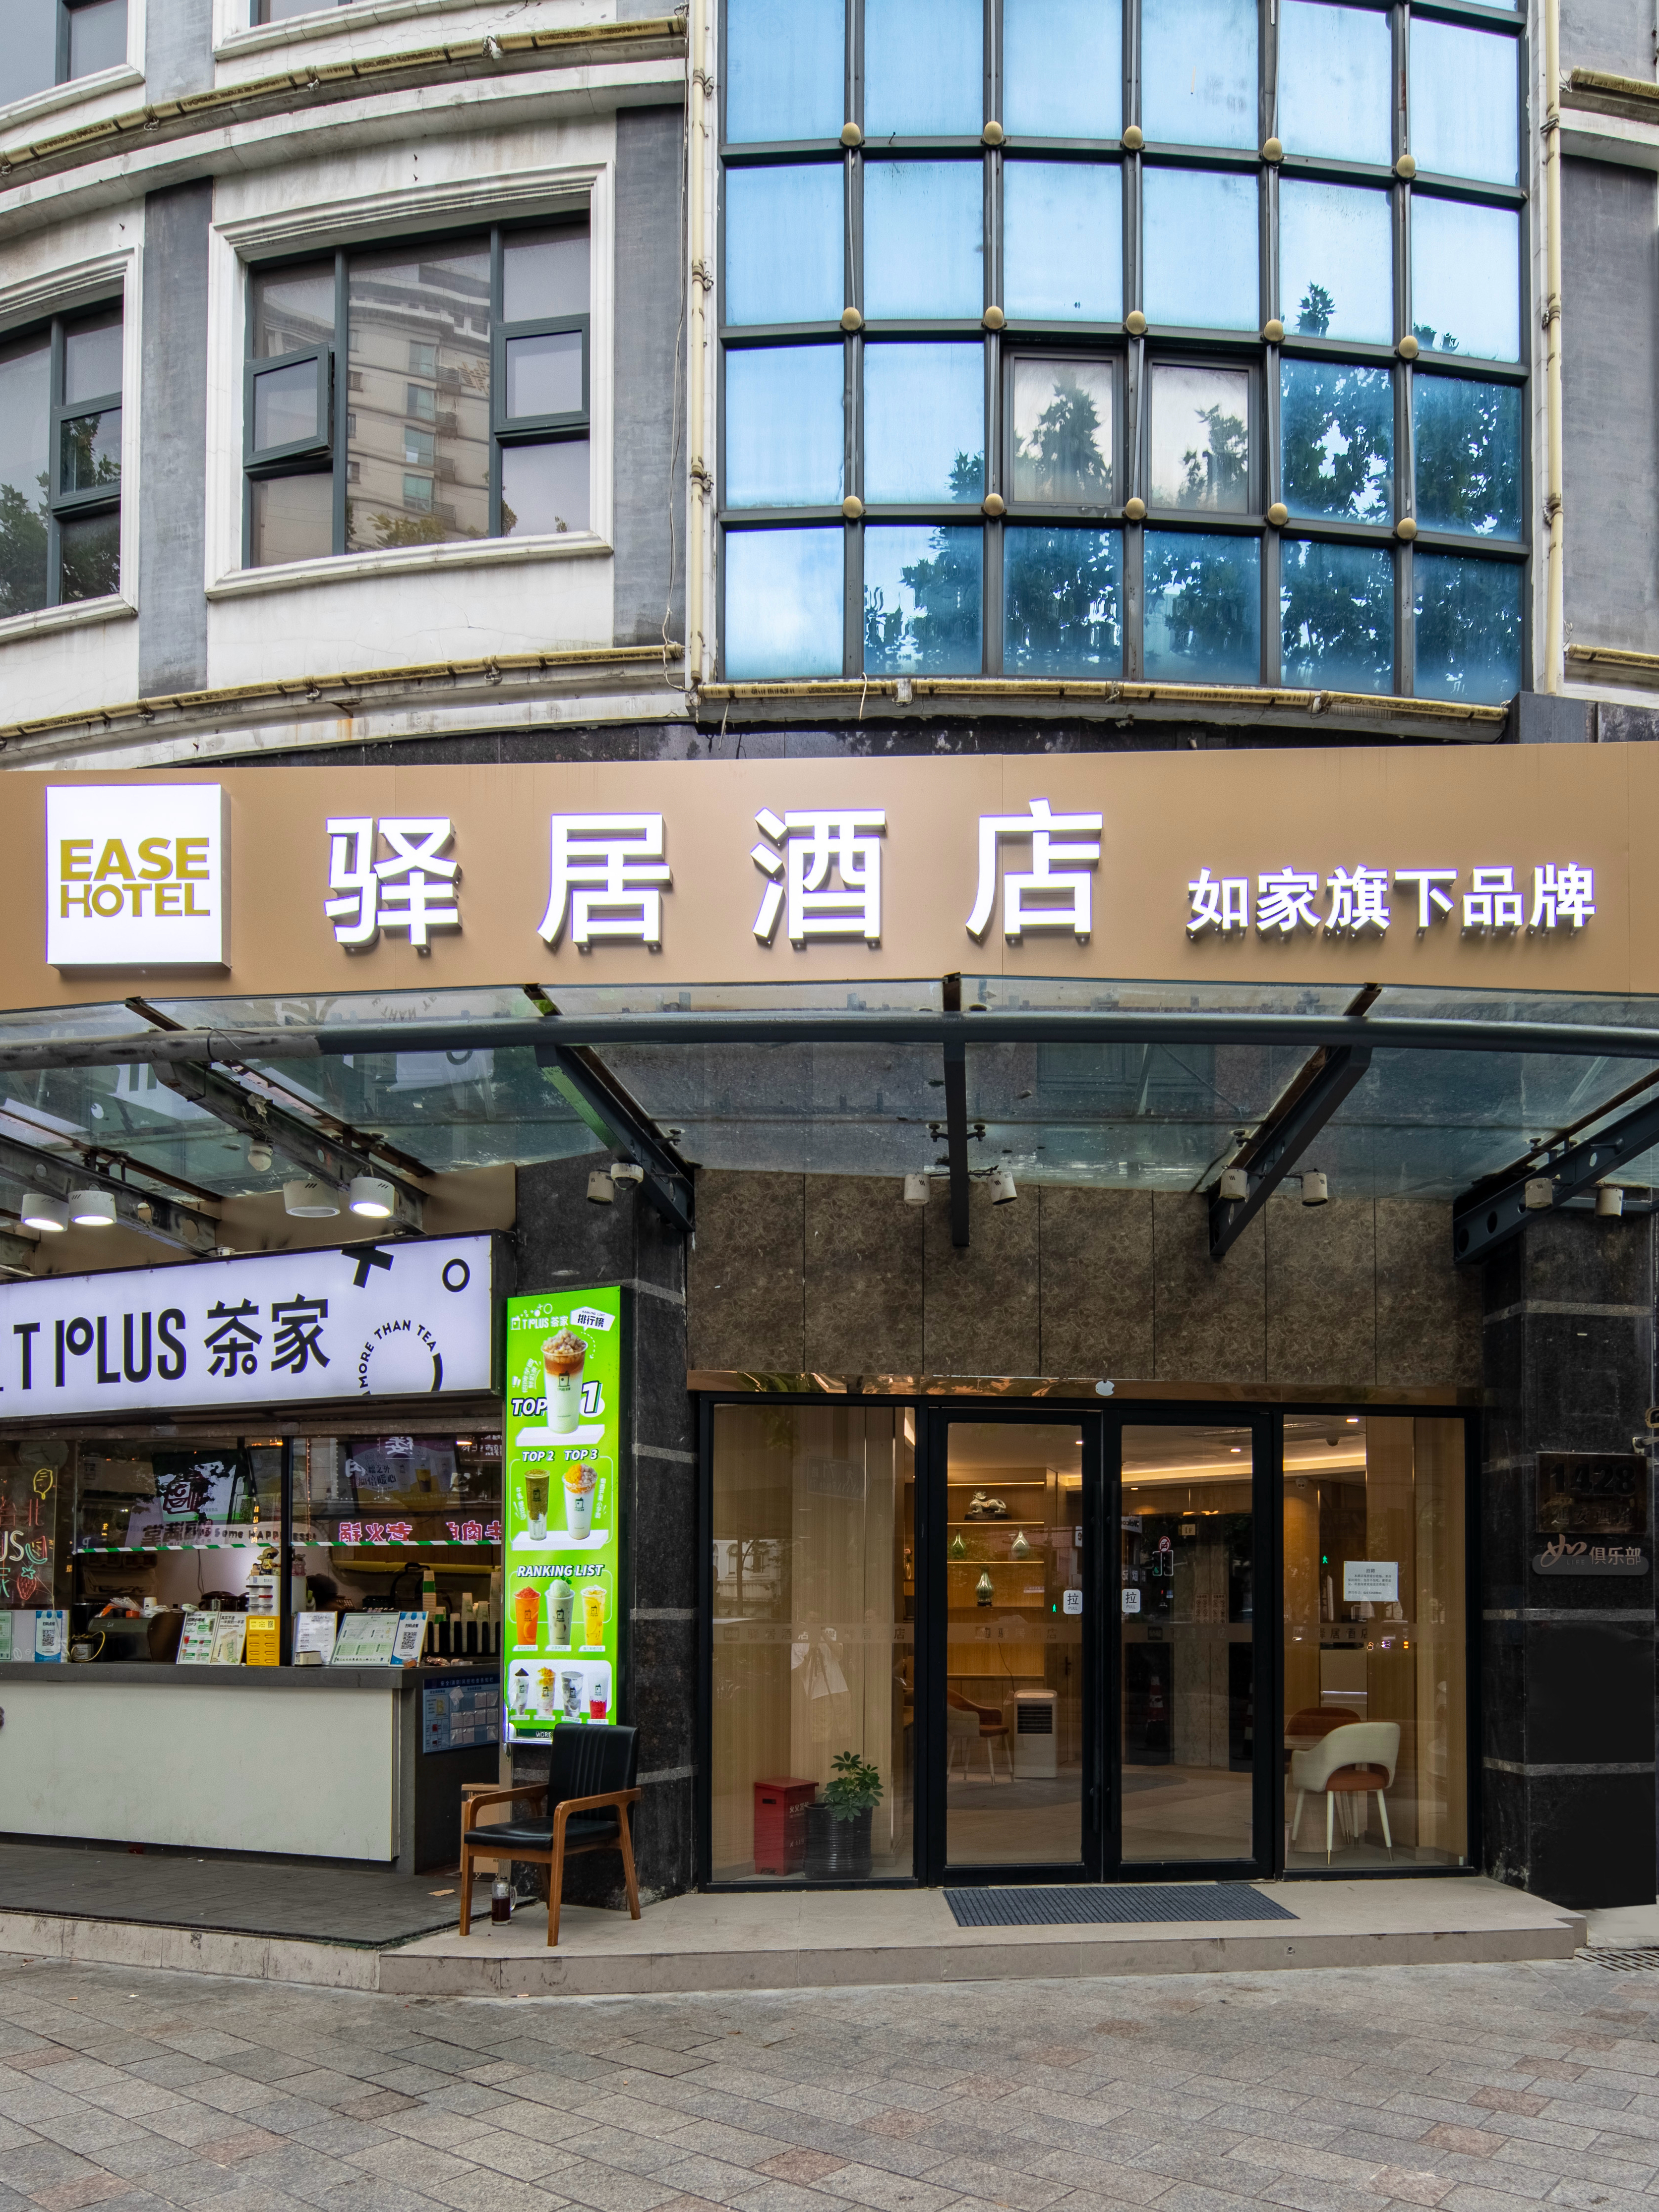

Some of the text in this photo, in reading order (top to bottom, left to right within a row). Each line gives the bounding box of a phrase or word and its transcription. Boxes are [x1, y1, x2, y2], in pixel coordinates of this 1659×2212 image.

[60, 838, 208, 880] EASE
[325, 799, 1103, 945] 驿居酒店
[60, 883, 210, 917] HOTEL
[1187, 863, 1597, 931] 如家旗下品牌
[528, 1316, 549, 1329] PLUS
[550, 1315, 569, 1327] 茶家
[577, 1314, 604, 1328] 排行榜
[13, 1293, 331, 1390] T PLUS 茶家
[358, 1319, 437, 1389] MORE THAN TEA
[512, 1380, 603, 1417] TOP 1
[522, 1450, 555, 1462] TOP 2
[564, 1449, 599, 1461] TOP 3
[1550, 1462, 1636, 1496] 1428
[1589, 1546, 1642, 1566] 俱乐部
[517, 1564, 605, 1578] RANKING LIST
[1067, 1593, 1079, 1606] 拉
[1125, 1591, 1137, 1605] 拉
